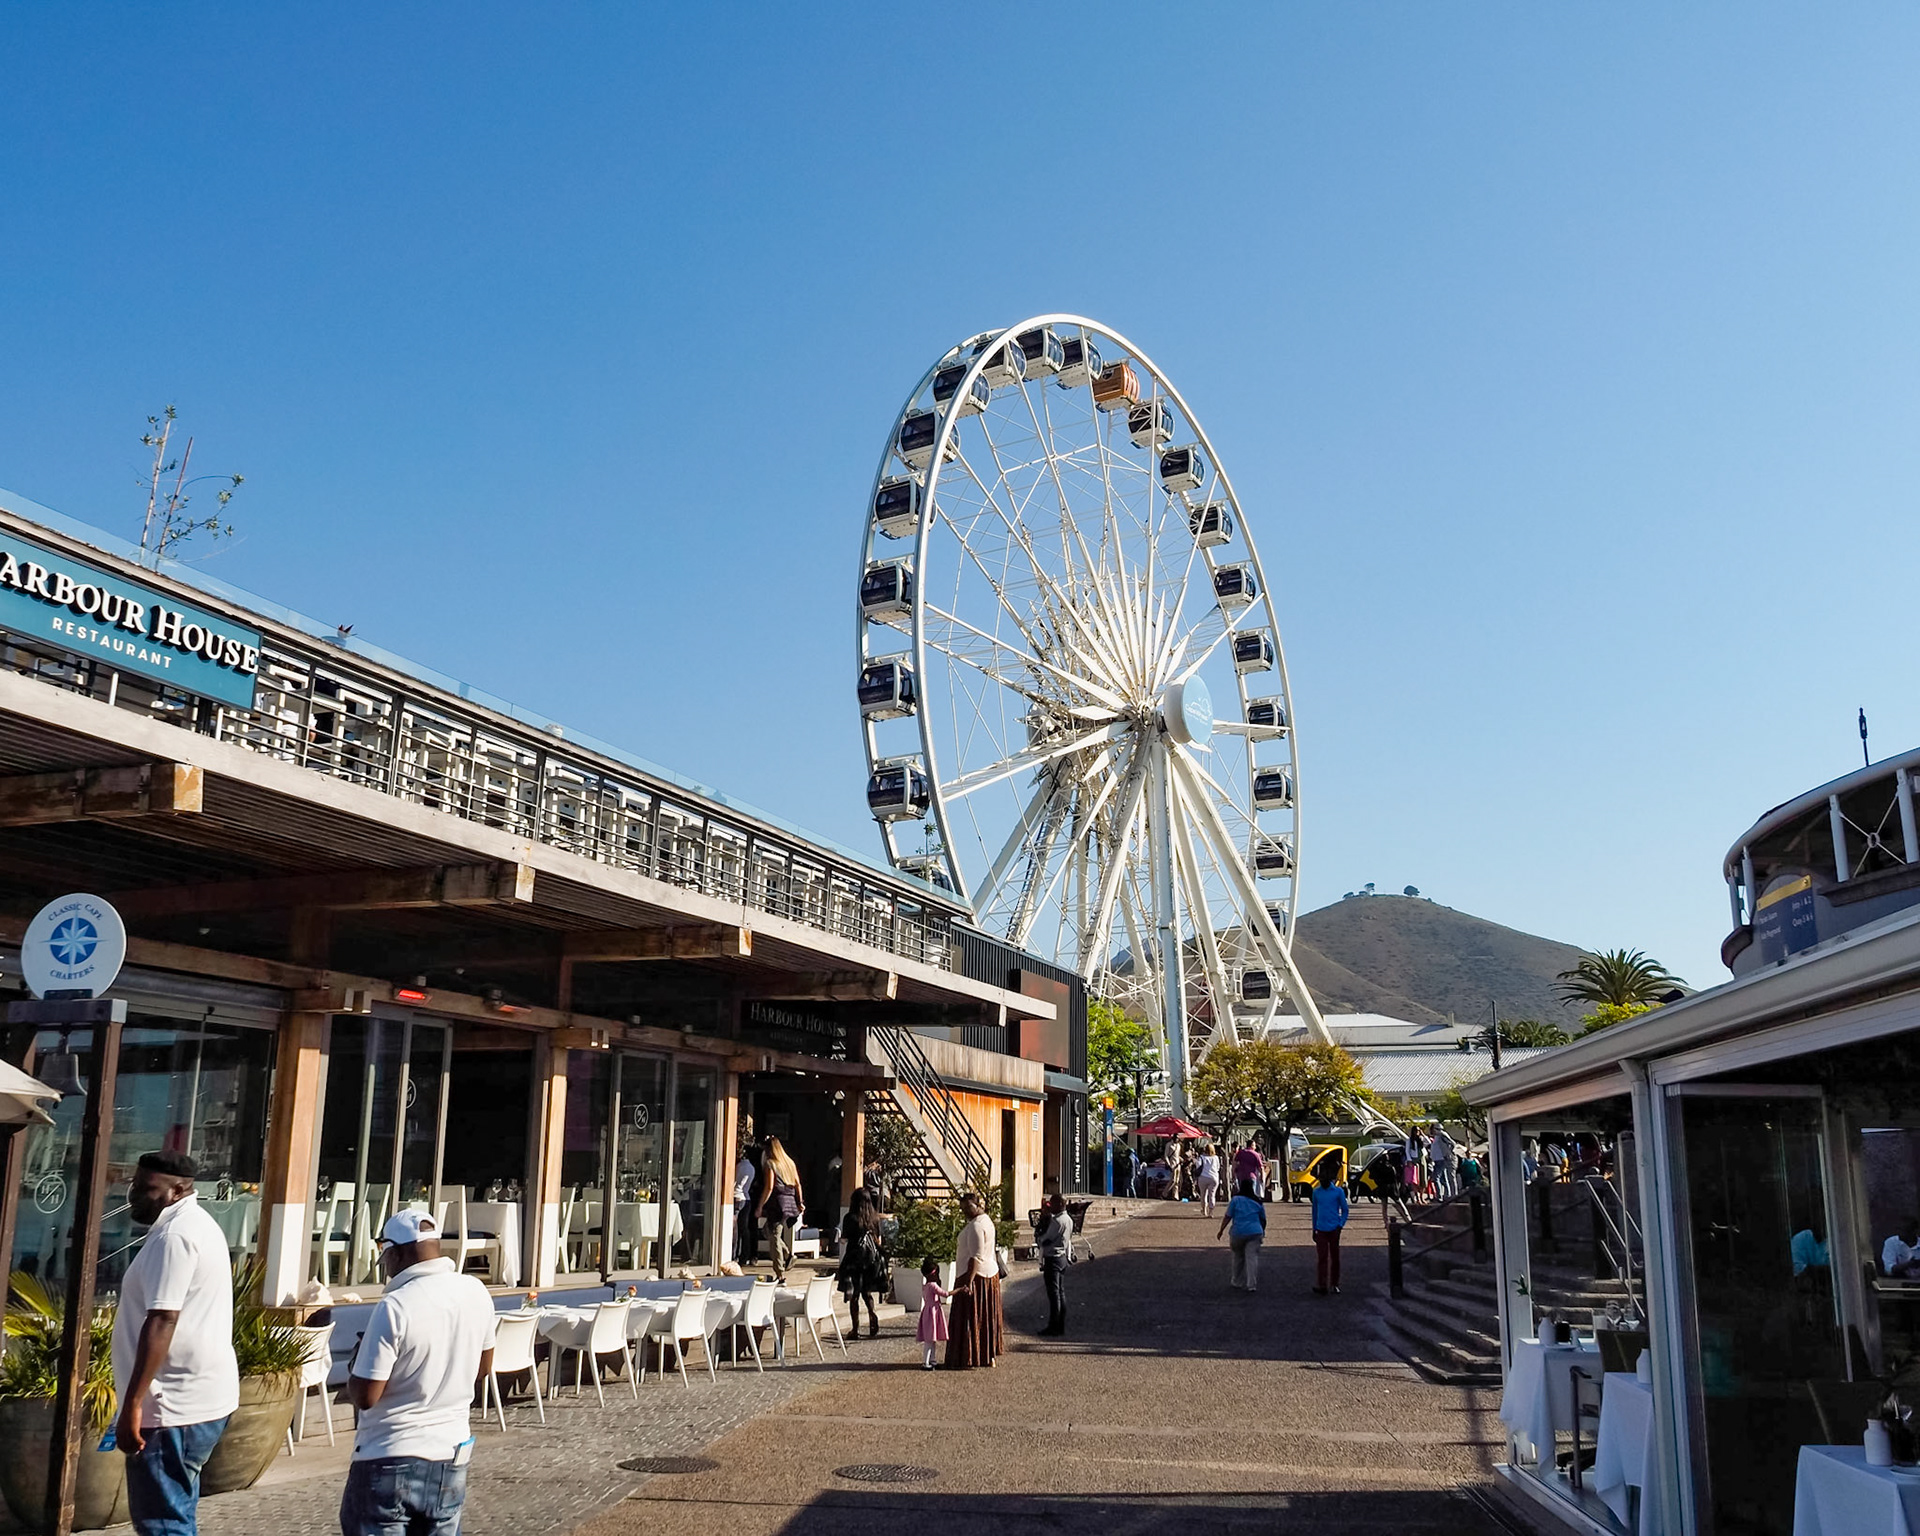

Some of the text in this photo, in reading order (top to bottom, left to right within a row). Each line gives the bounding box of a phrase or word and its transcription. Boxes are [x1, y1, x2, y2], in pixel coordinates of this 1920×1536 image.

[52, 617, 173, 669] RESTAURANT
[153, 605, 260, 674] HOUSE
[48, 903, 104, 921] CLASSIC CAPE
[49, 964, 95, 980] CHARTERS
[751, 1002, 803, 1028] HARBOUR
